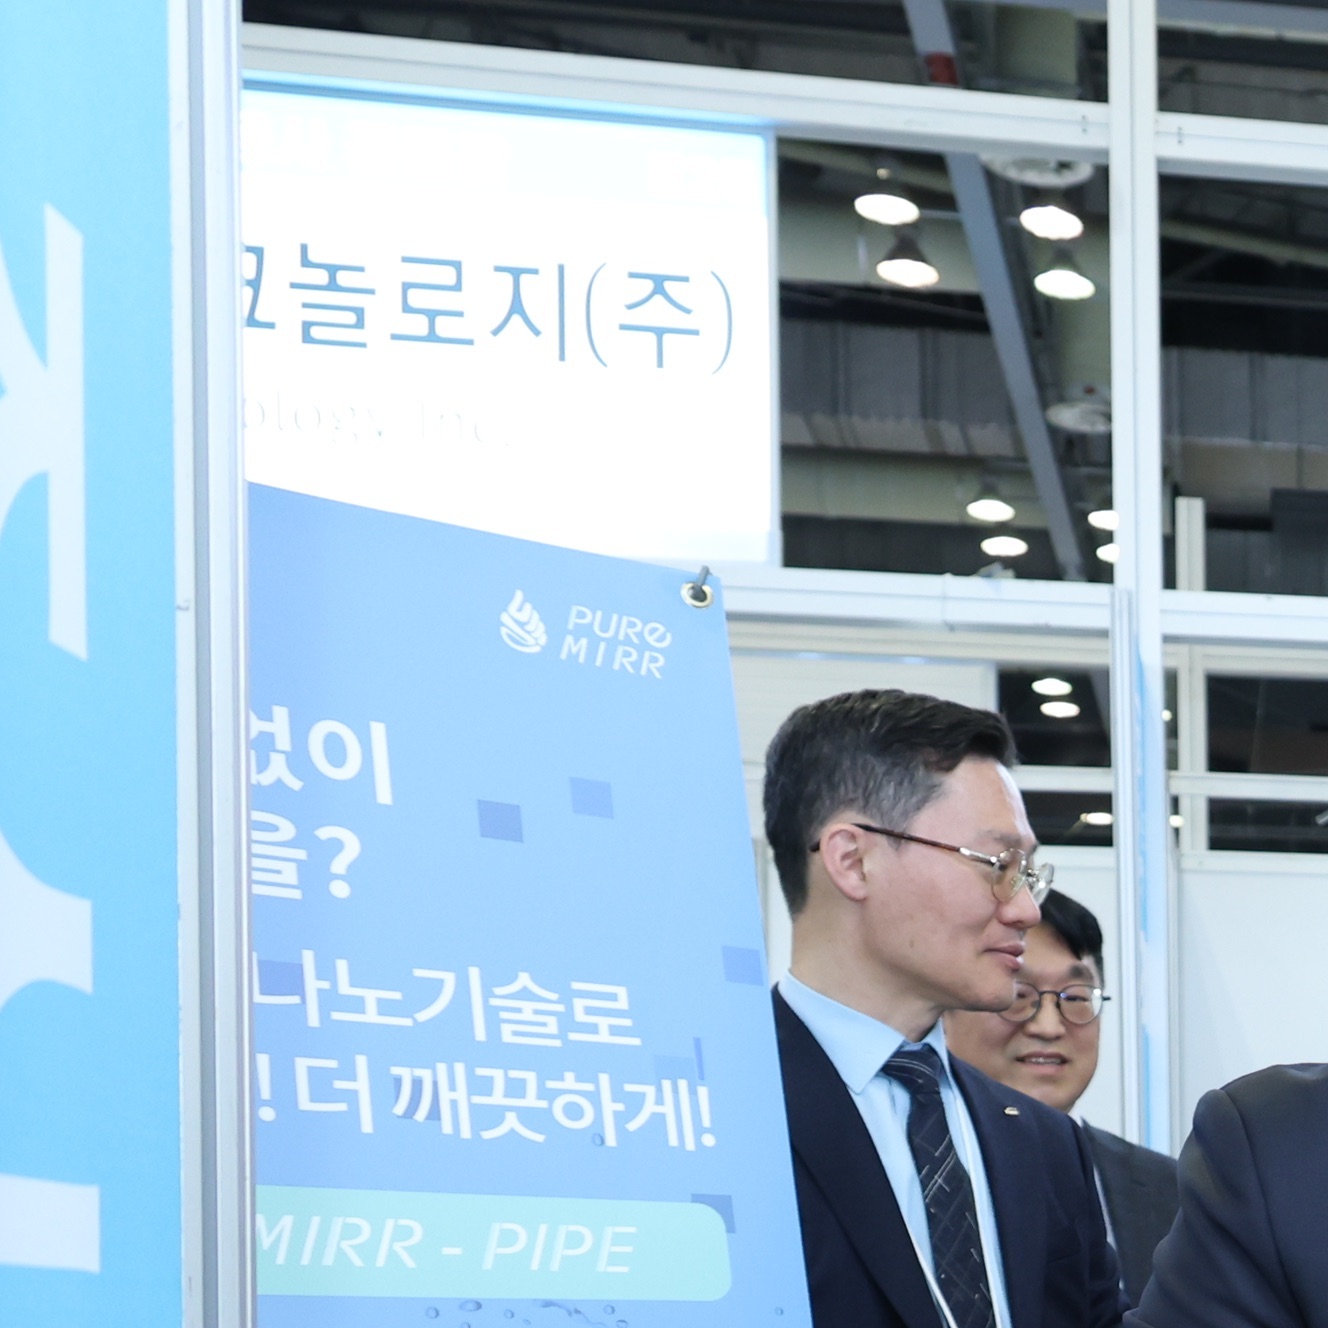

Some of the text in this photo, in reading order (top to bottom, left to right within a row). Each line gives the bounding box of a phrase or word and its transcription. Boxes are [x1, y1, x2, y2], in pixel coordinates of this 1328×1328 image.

[559, 641, 666, 680] MIRR
[251, 949, 642, 1048] 나노기술로
[293, 1053, 375, 1135] 더
[388, 1061, 717, 1151] 깨끗하게!
[255, 1212, 424, 1270] MIRR
[481, 1221, 639, 1275] PIPE
